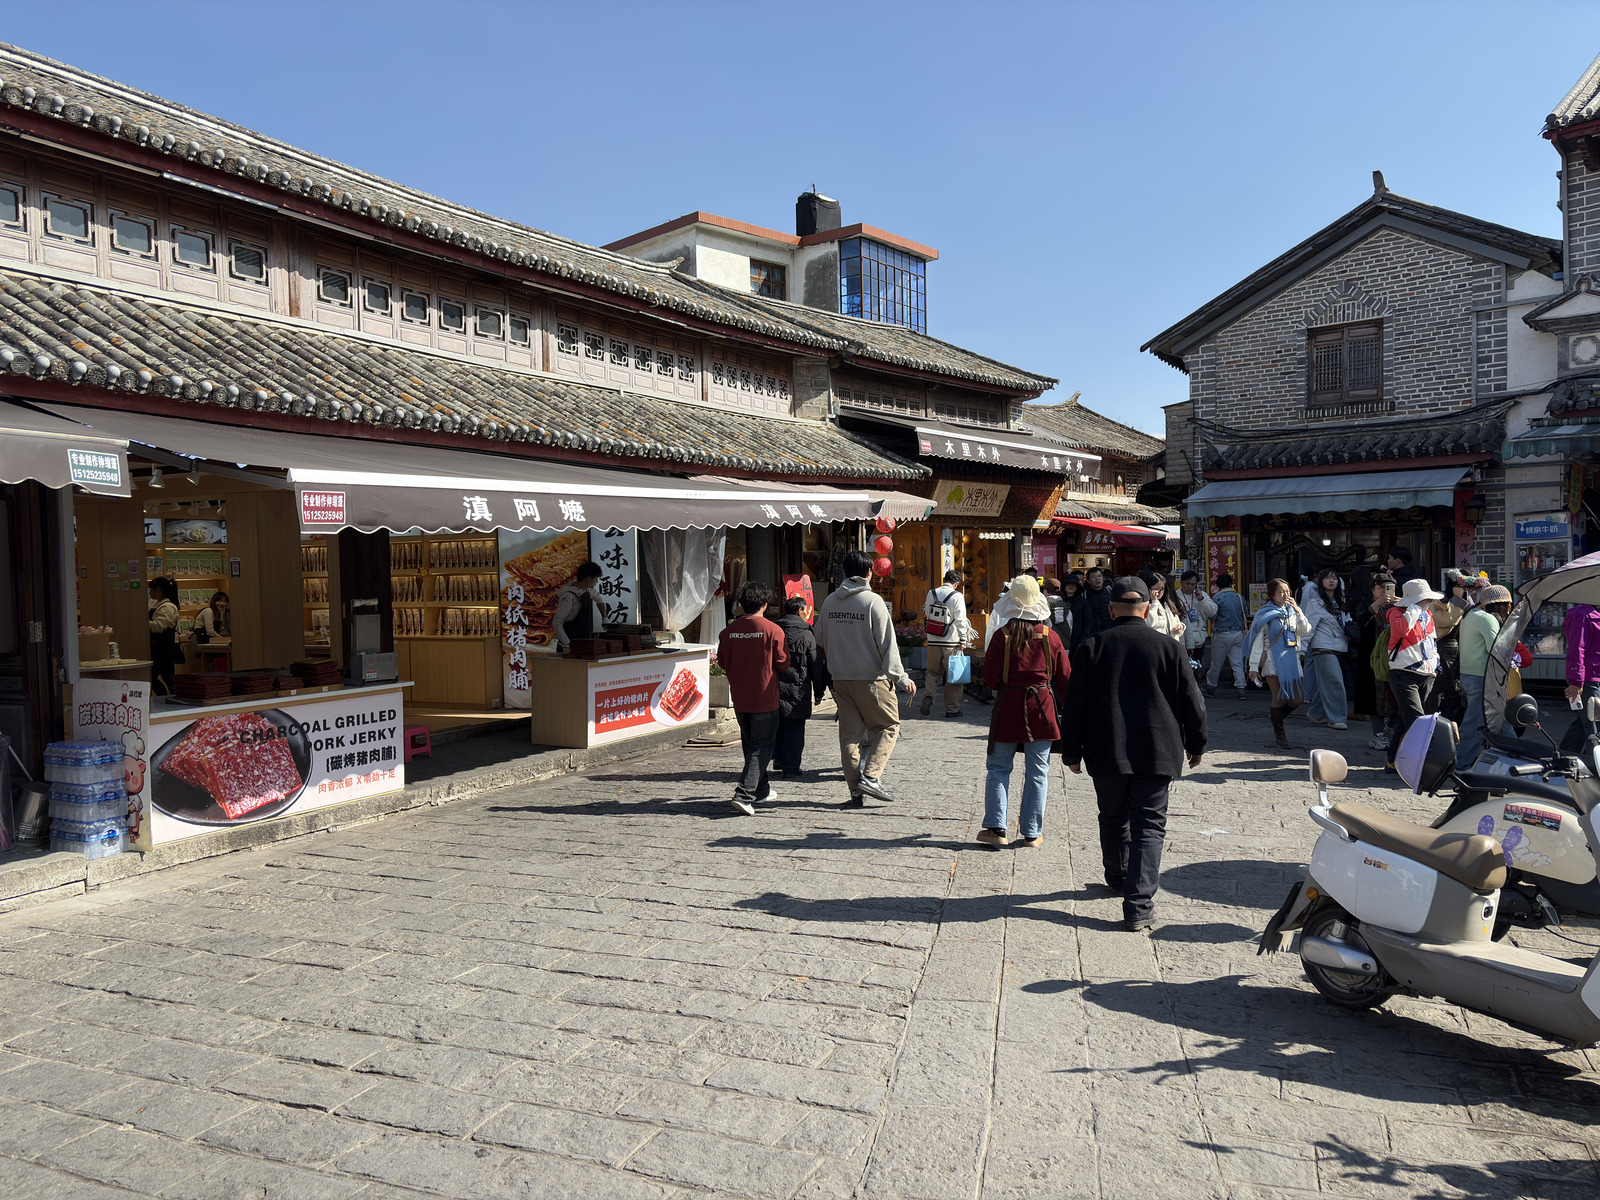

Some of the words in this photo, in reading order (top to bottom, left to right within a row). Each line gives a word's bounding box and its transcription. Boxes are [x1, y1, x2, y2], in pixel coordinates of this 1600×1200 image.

[945, 440, 1000, 462] 木里木外
[1040, 454, 1084, 473] 木里木外
[73, 468, 119, 482] 15125235948
[303, 510, 344, 520] 15125235948
[462, 495, 587, 522] 滇阿嬷
[760, 504, 828, 519] 滇阿嬷
[1525, 525, 1559, 535] 蝶泉牛奶
[828, 611, 865, 621] ESSENTIALS
[504, 582, 529, 691] 肉纸猪肉脯
[596, 692, 649, 708] 一片上好的猪肉片
[600, 706, 646, 724] 应该是什么味道
[239, 718, 332, 744] CHARCOAL
[335, 709, 397, 729] GRILLED
[303, 735, 346, 754] PORK
[349, 727, 397, 746] JERKY
[318, 776, 353, 795] 肉香浓郁
[363, 768, 396, 783] 嚼劲十足
